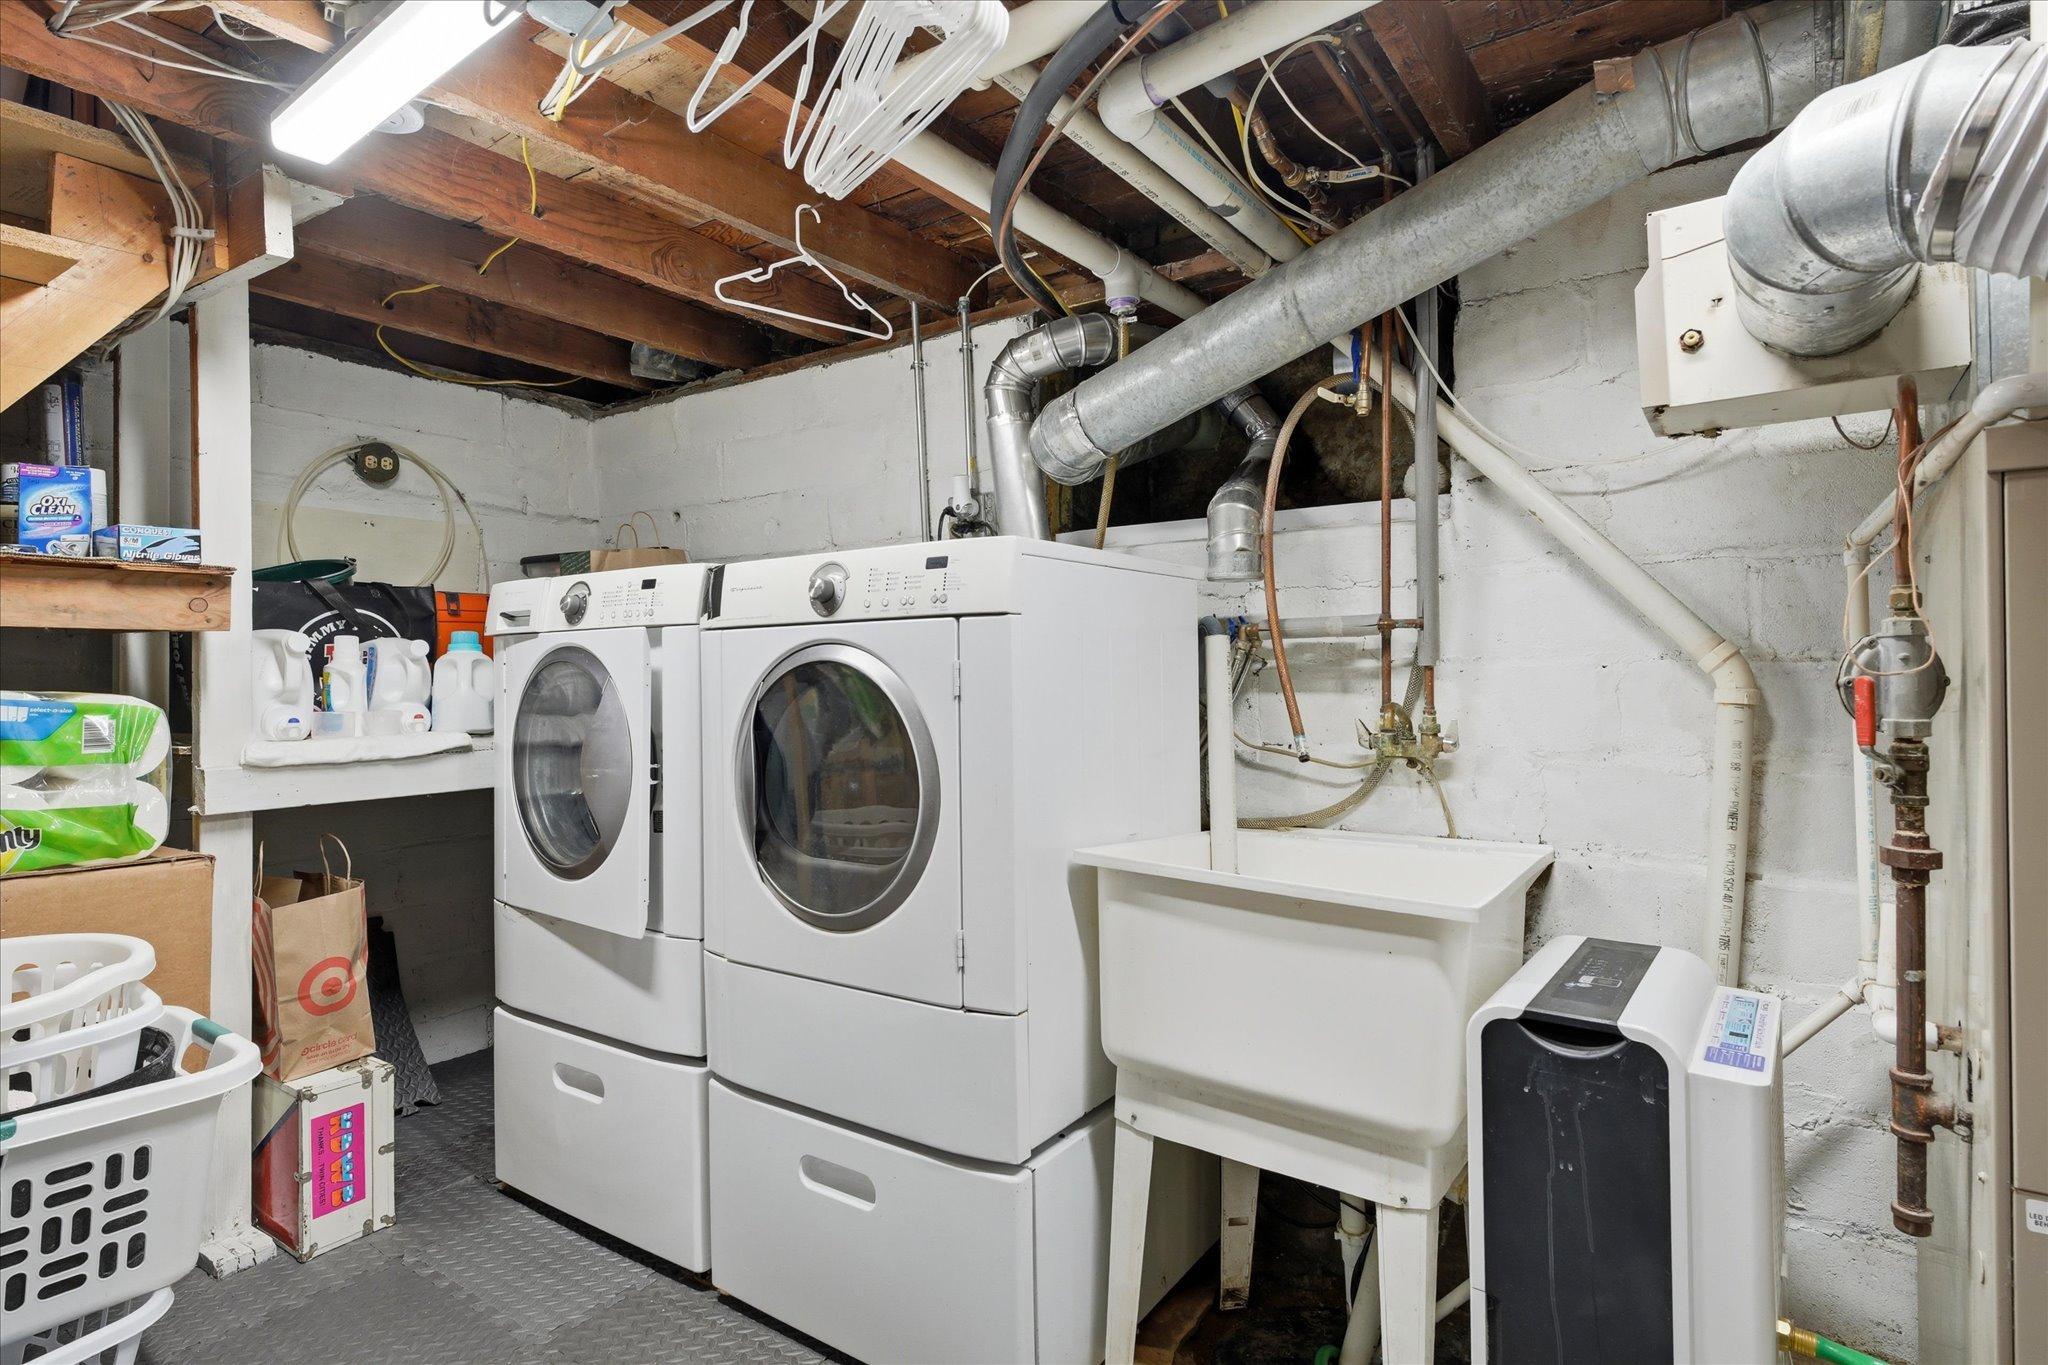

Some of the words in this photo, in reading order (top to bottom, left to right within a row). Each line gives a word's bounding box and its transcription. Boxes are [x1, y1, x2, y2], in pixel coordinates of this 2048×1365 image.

[40, 495, 68, 506] OXI
[30, 504, 76, 515] CLEAN
[122, 550, 161, 562] Nitrile
[163, 552, 200, 562] Gloves
[309, 1040, 337, 1053] circle
[338, 1032, 357, 1044] card
[329, 1111, 355, 1207] KDWB
[2029, 1212, 2044, 1220] LED
